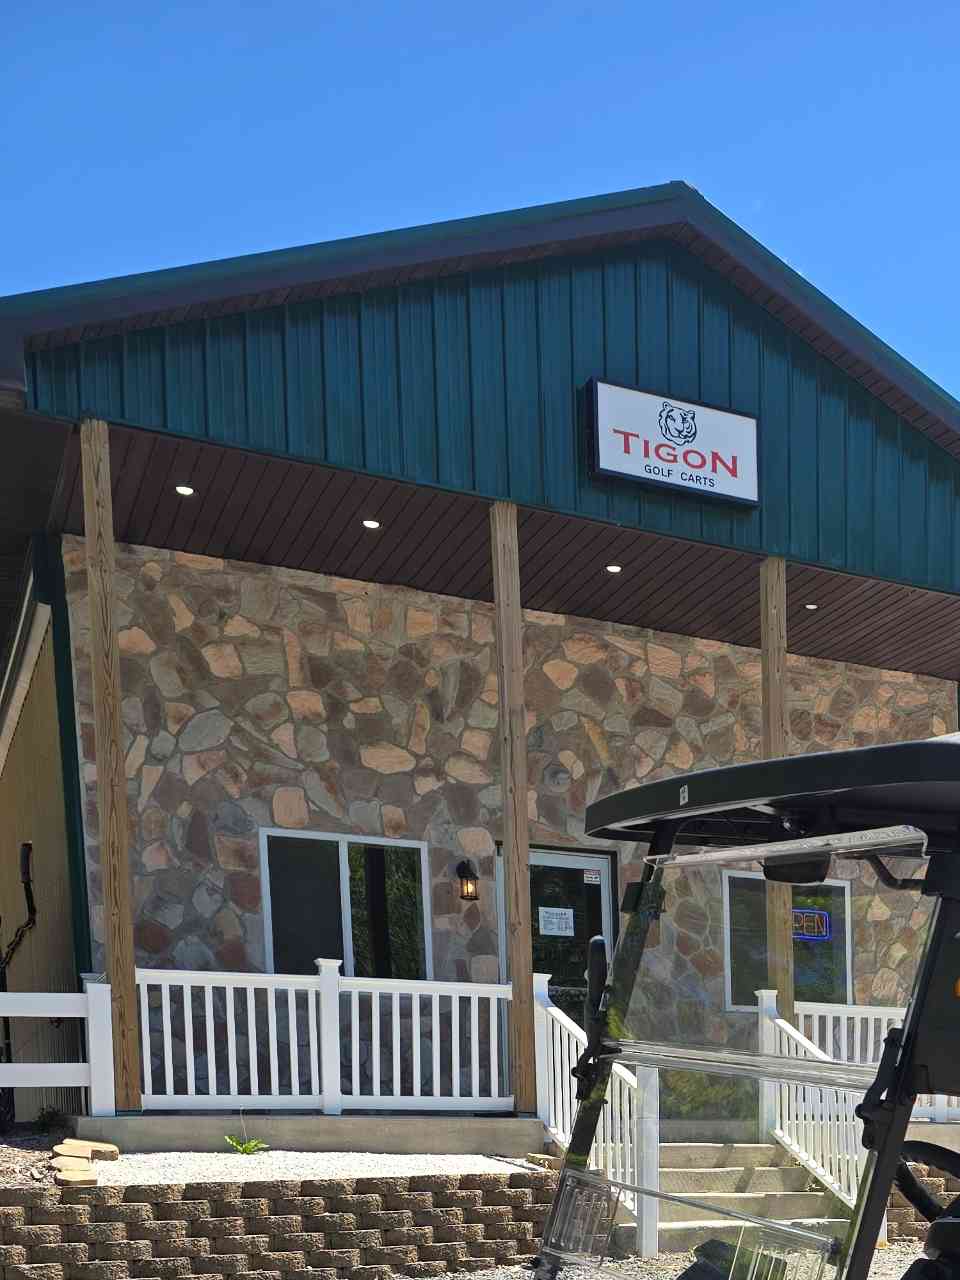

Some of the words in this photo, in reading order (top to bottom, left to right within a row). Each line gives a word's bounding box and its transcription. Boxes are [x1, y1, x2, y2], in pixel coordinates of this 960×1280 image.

[612, 428, 738, 478] TIGON
[644, 464, 673, 478] GOLF
[681, 472, 715, 487] CARTS
[792, 913, 826, 935] PEN
